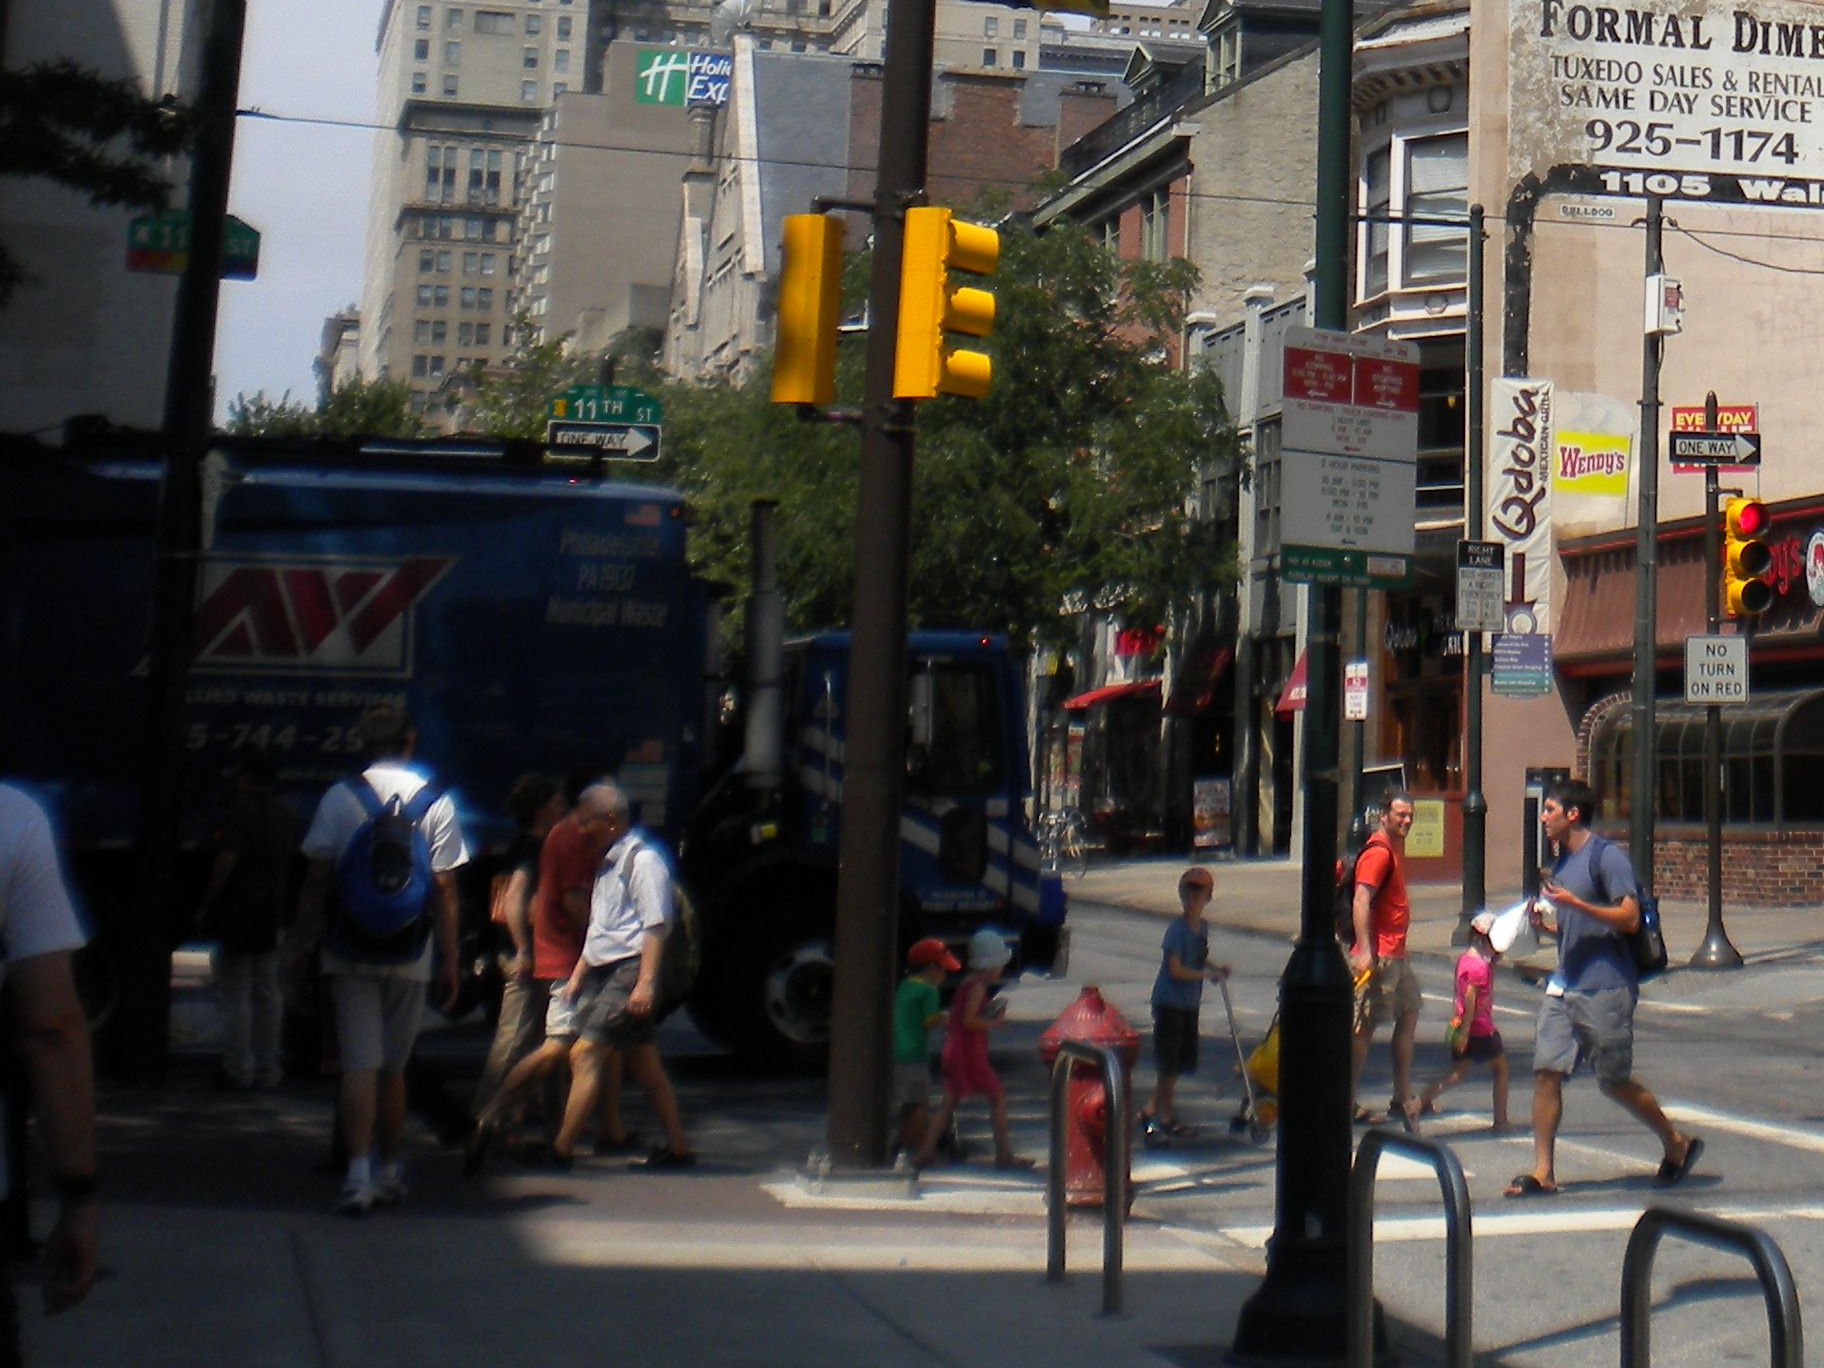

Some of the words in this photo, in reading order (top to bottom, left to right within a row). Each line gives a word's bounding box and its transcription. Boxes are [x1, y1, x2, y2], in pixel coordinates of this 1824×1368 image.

[1550, 55, 1643, 84] TUXEDO
[1652, 63, 1713, 90] SALES
[1722, 70, 1738, 92] &
[1561, 85, 1636, 110] SAME
[1649, 90, 1699, 115] DAY
[1711, 95, 1813, 123] SERVICE
[1585, 118, 1799, 165] 925-1174
[1600, 170, 1711, 197] 1105
[1562, 205, 1613, 217] BULLDOG
[574, 398, 624, 420] 11TH
[637, 407, 653, 422] ST
[1676, 412, 1752, 426] EVEYDAY
[1539, 425, 1550, 482] MEXICAN
[1679, 440, 1704, 455] ONE
[1708, 440, 1734, 455] WAY
[1492, 389, 1547, 541] Qdoba
[1468, 545, 1495, 555] RIGHT
[1469, 556, 1492, 566] LANE
[1706, 644, 1727, 657] NO
[1699, 663, 1735, 677] TURN
[1691, 682, 1710, 696] ON
[1716, 682, 1742, 696] RED
